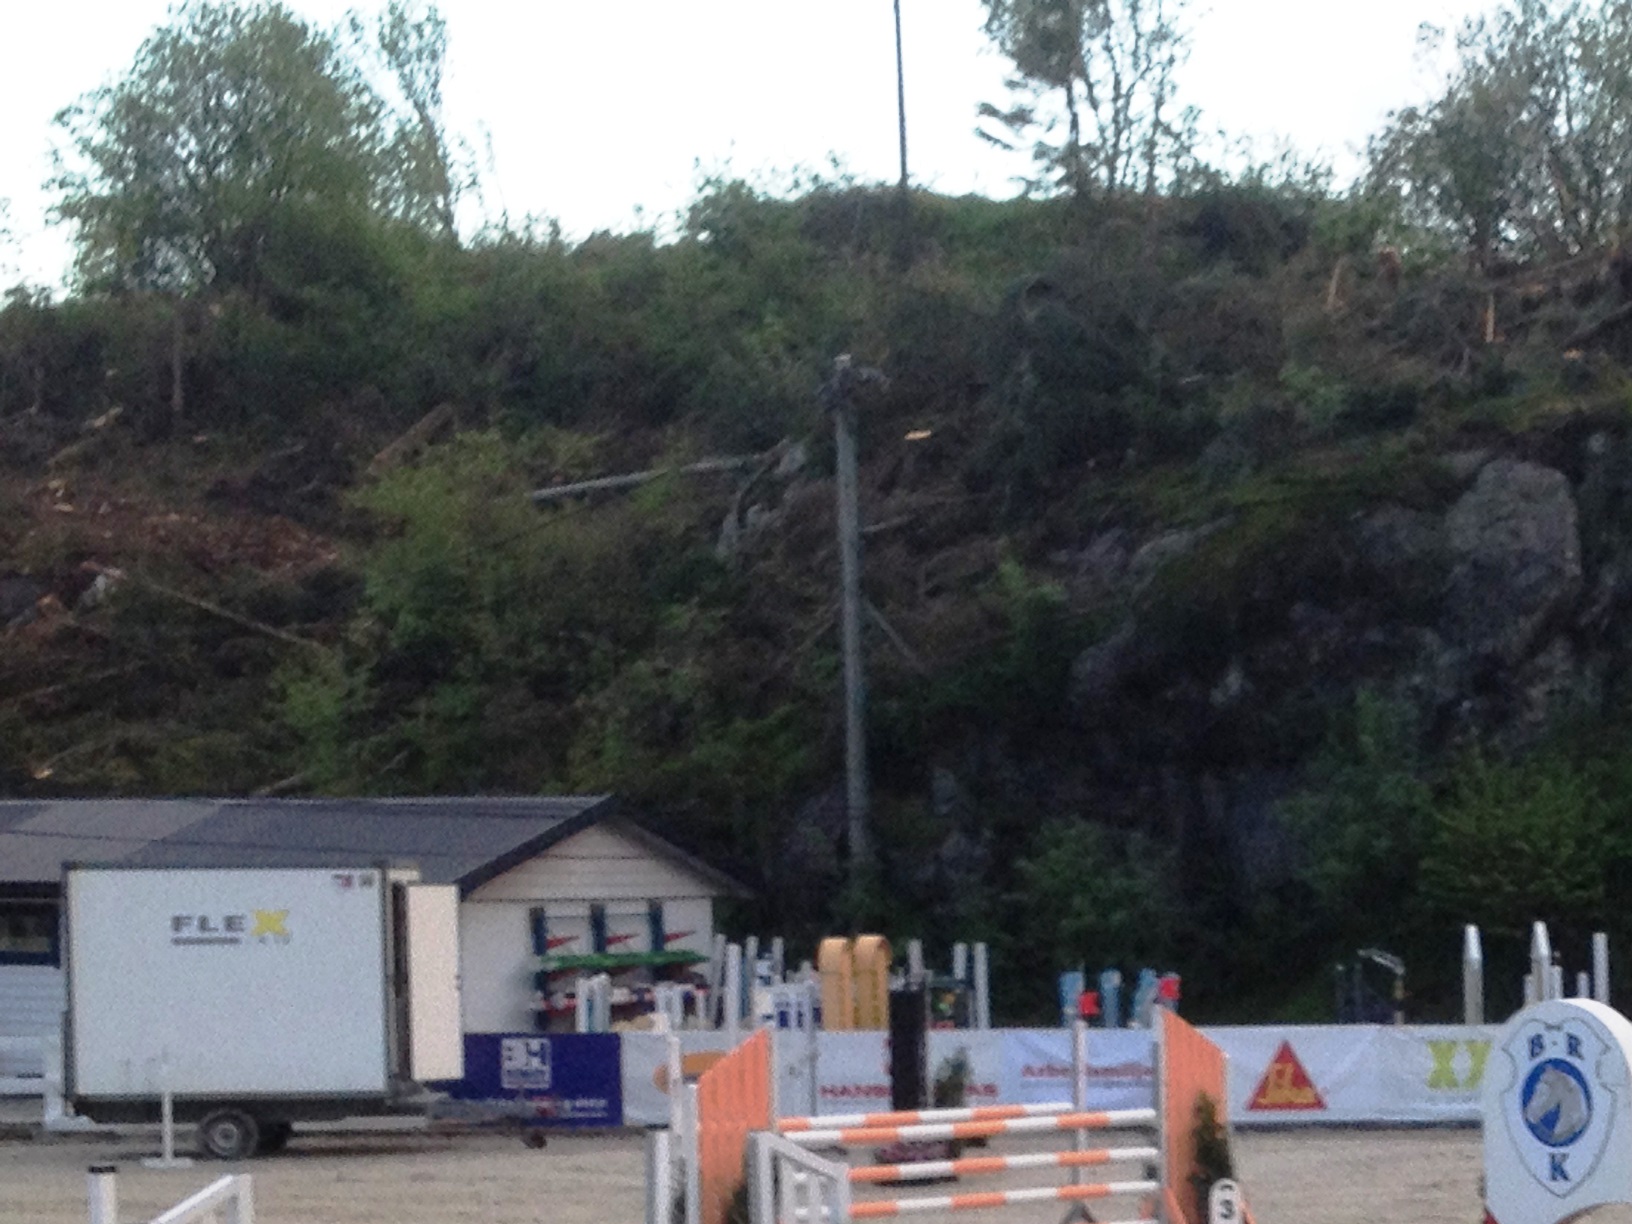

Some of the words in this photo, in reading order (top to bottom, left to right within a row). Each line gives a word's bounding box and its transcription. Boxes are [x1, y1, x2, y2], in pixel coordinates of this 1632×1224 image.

[171, 909, 290, 937] FLEX
[1549, 1152, 1570, 1182] K
[1219, 1199, 1235, 1219] 3
